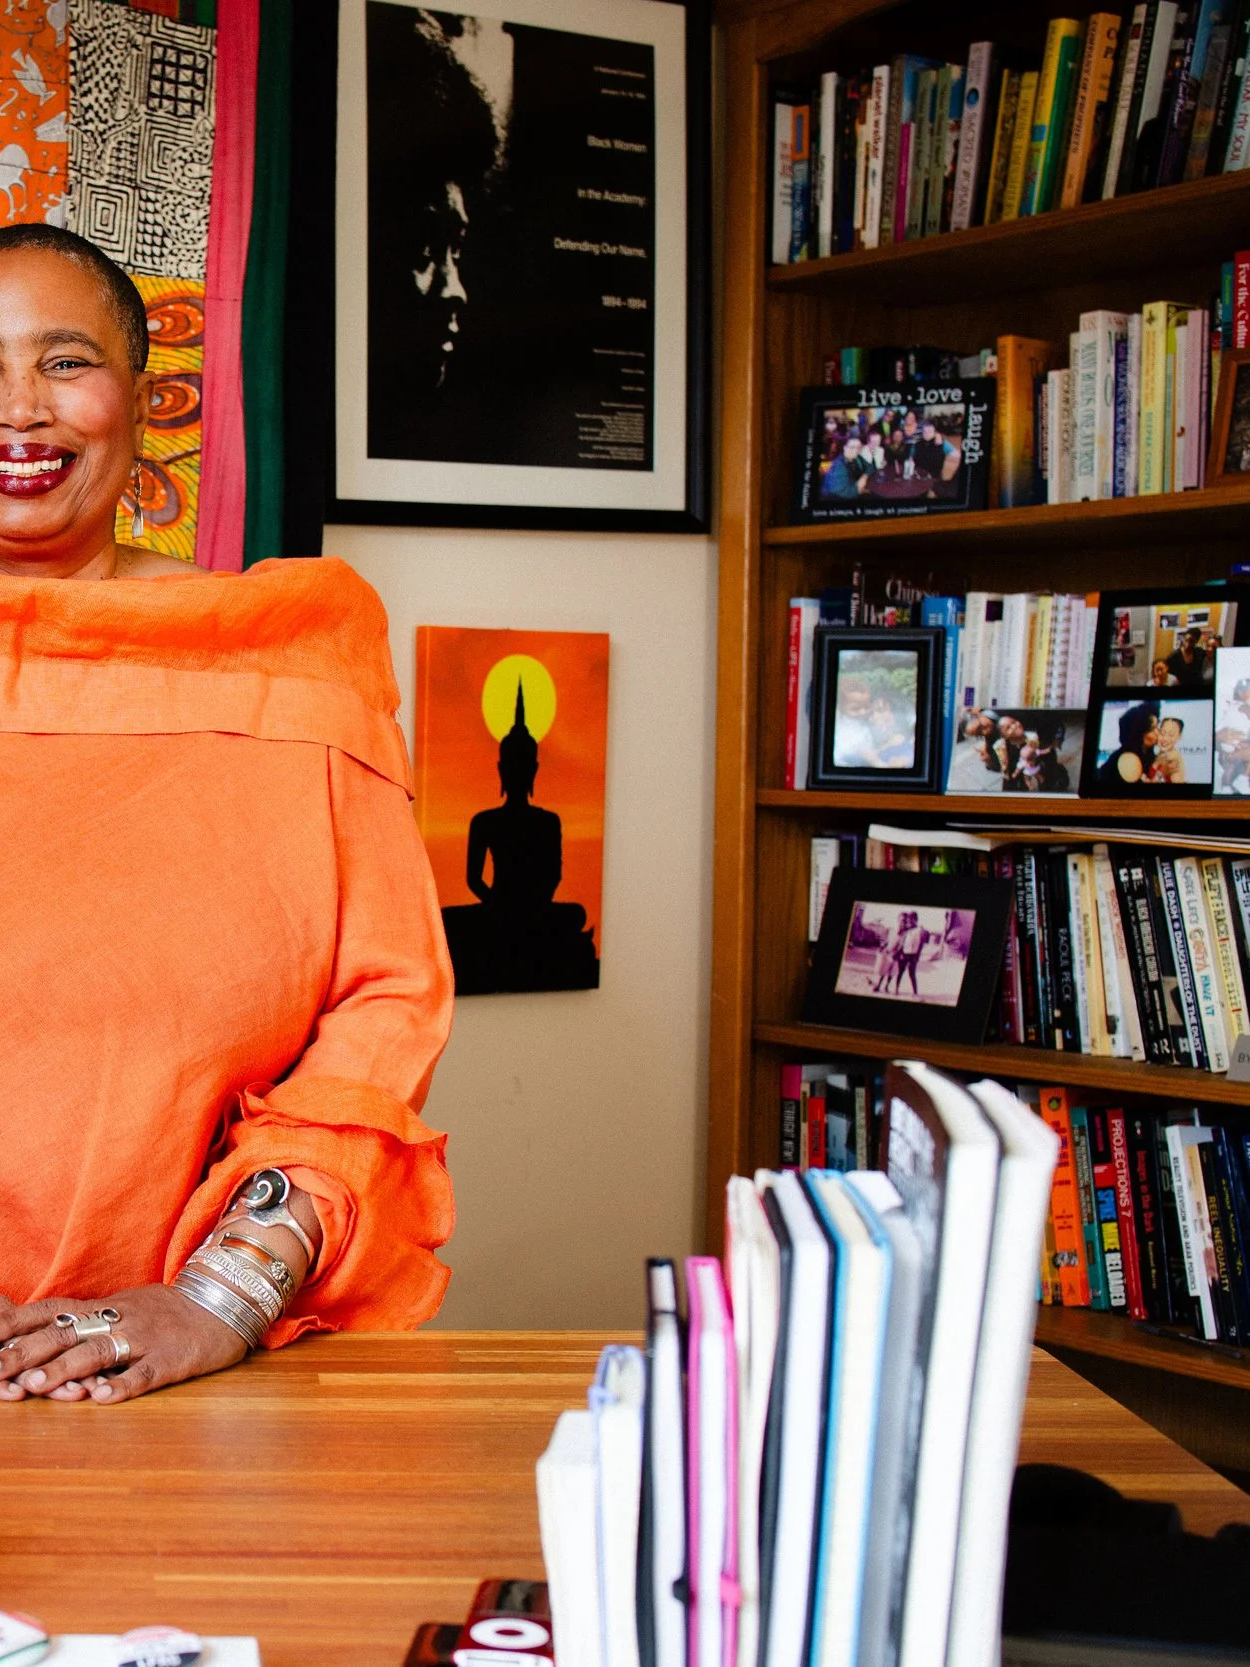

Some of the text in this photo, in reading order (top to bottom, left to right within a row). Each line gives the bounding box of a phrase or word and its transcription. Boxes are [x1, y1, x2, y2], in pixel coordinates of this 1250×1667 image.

[1236, 263, 1250, 348] For the Cultur
[857, 386, 988, 465] live love laugh
[1161, 861, 1175, 888] JULIE
[1136, 898, 1149, 921] BLACK
[1167, 891, 1180, 919] DASH
[1139, 921, 1155, 955] AMERICAN
[1057, 928, 1073, 1002] RAOUL PECK
[1145, 955, 1159, 982] CINEMA
[1172, 931, 1191, 991] DAUGHTERS
[1199, 974, 1213, 1002] HAVE
[1188, 1004, 1199, 1025] THE
[1204, 1005, 1216, 1017] IT
[1191, 1025, 1203, 1053] DUST
[1111, 1118, 1132, 1218] PROJECTIONS 7
[1136, 1149, 1151, 1182] Images
[1177, 1185, 1188, 1222] TELEVISION
[1096, 1188, 1127, 1307] SPIKE MIKE RELOADED
[1182, 1224, 1190, 1239] AND
[1207, 1195, 1230, 1294] REEL INEQUALITY
